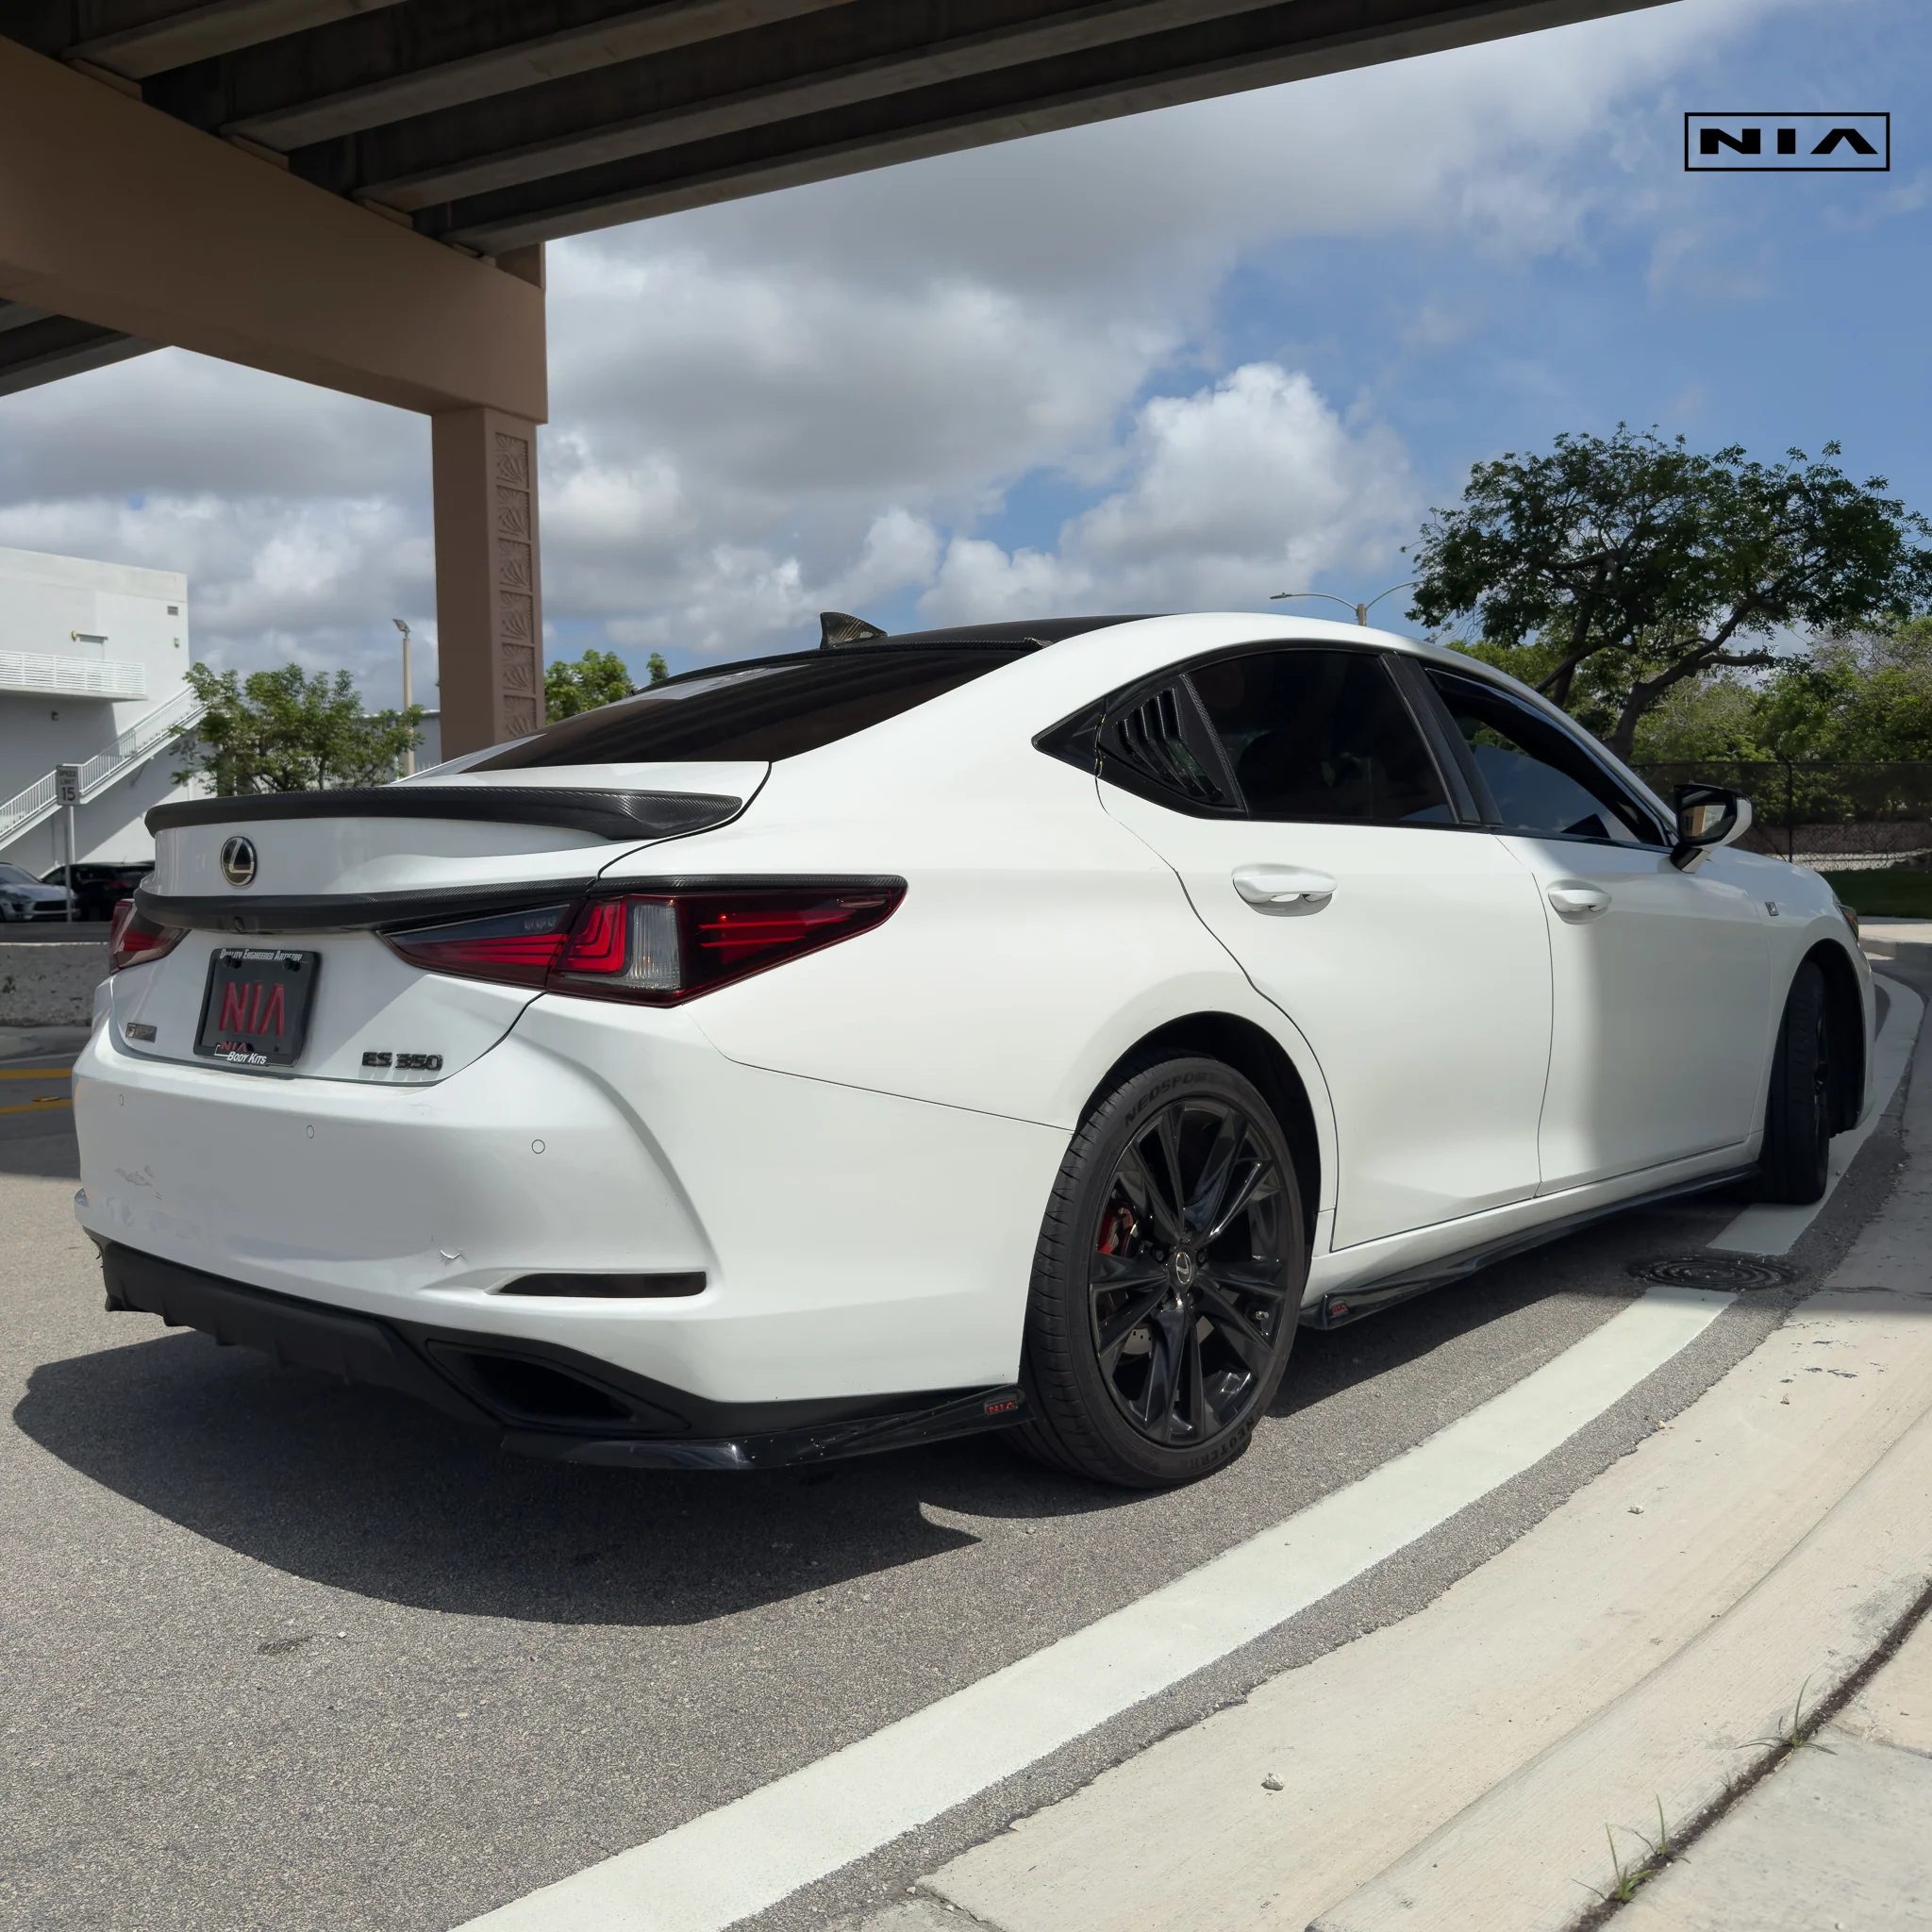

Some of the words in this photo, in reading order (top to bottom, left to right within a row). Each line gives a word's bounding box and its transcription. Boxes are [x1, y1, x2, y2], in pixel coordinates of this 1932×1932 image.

[62, 787, 75, 801] 15
[218, 981, 286, 1037] NIA
[220, 1041, 248, 1053] NIA
[226, 1051, 250, 1062] BODY
[248, 1052, 268, 1065] KITS
[361, 1051, 393, 1068] ES
[394, 1053, 444, 1072] 350
